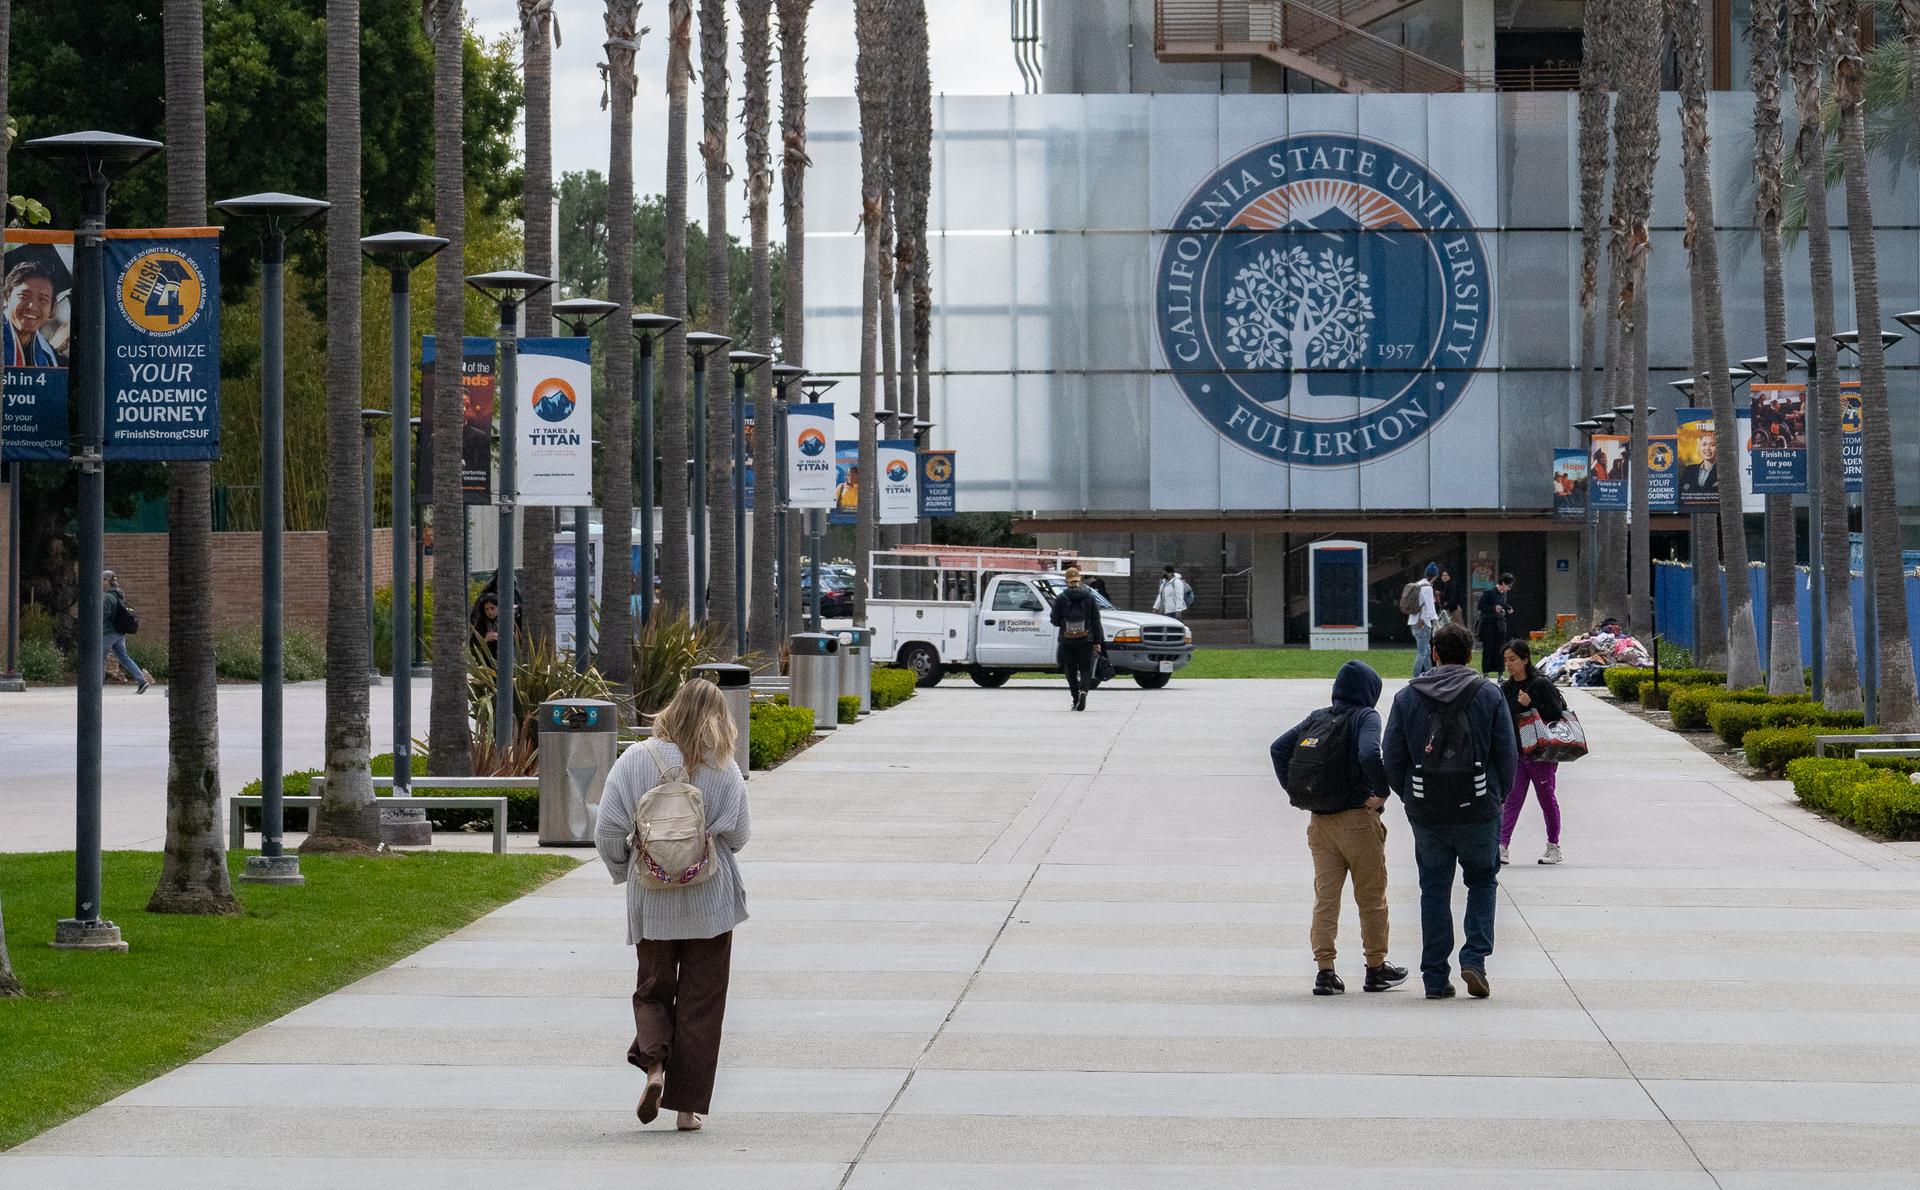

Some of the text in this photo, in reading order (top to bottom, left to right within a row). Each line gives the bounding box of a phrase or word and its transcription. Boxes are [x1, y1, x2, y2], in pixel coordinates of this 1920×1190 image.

[124, 256, 137, 269] TAKE
[170, 248, 186, 258] YEAR
[1167, 146, 1480, 364] CALIFORNIA STATE UNIVERSITY
[186, 257, 205, 282] DECLARE
[130, 260, 161, 303] FINISH
[153, 282, 165, 295] IN
[144, 272, 184, 324] 4
[117, 345, 206, 358] CUSTOMIZE
[1378, 344, 1415, 360] 1957
[129, 364, 193, 382] YOUR
[467, 362, 476, 373] of
[477, 363, 490, 373] the
[20, 372, 32, 385] in
[36, 373, 46, 386] 4
[8, 394, 36, 406] you
[116, 389, 207, 403] ACADEMIC
[116, 406, 207, 422] JOURNEY
[13, 424, 38, 432] today!
[114, 429, 210, 440] #FinishStrongCSUF
[1225, 399, 1430, 456] FULLERTON
[2, 439, 64, 447] FinishStrongCSUF
[528, 434, 580, 445] TITAN
